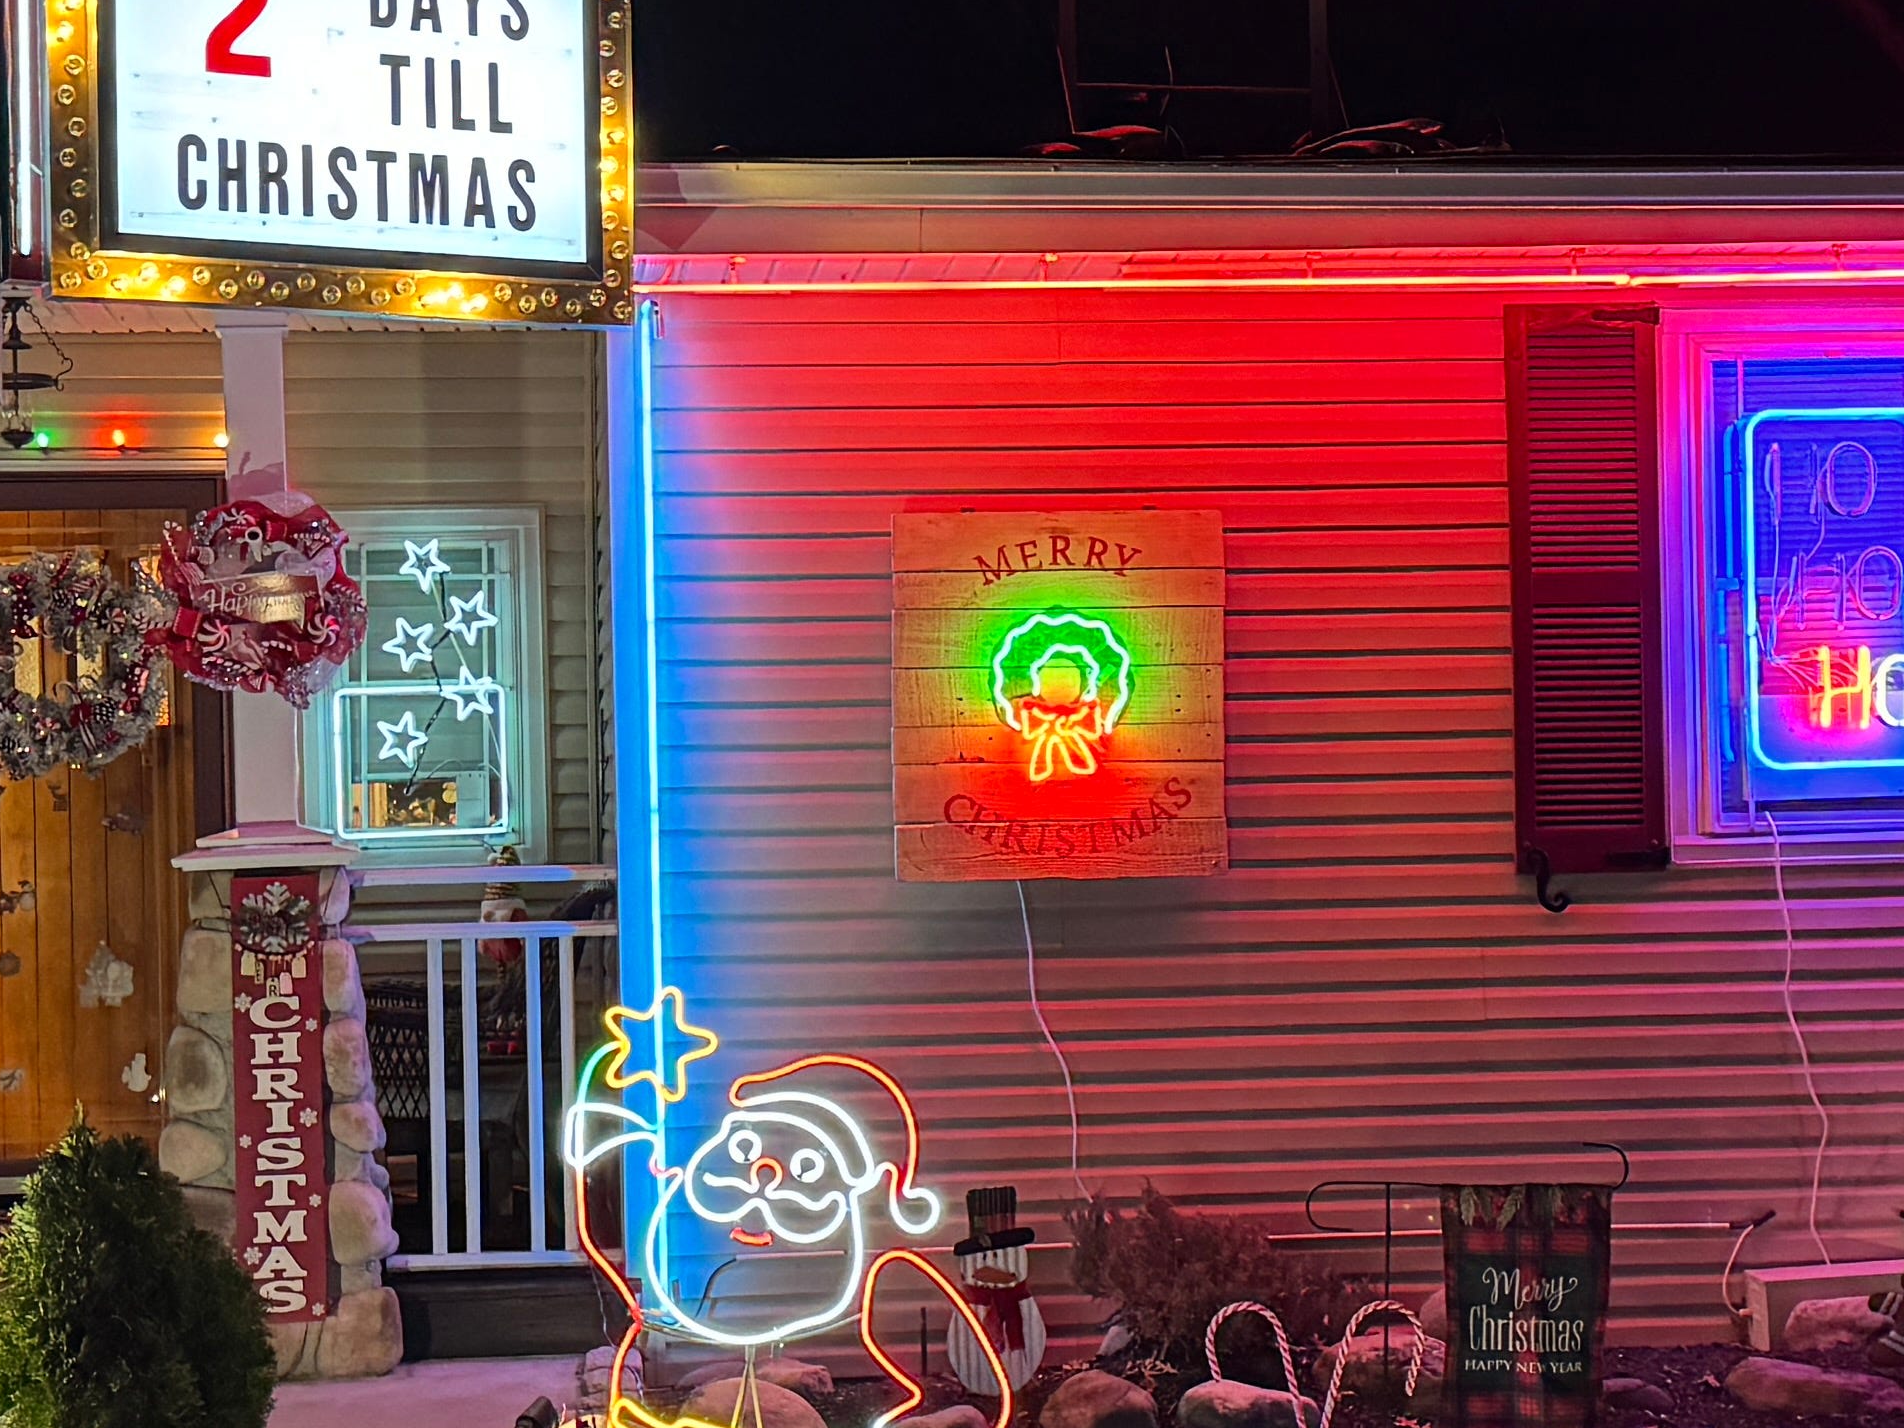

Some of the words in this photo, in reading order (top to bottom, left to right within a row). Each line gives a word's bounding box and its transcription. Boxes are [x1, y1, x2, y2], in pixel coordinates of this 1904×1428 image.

[379, 54, 514, 136] TILL
[176, 133, 537, 232] CHRISTMAS
[973, 535, 1142, 586] MERRY
[943, 776, 1192, 857] CHRISTMAS
[249, 996, 309, 1314] CHRISTMAS
[1482, 1267, 1579, 1312] Merry
[1469, 1304, 1584, 1353] Christmas
[1465, 1359, 1513, 1372] HAPPY
[1516, 1361, 1547, 1374] NEW
[1549, 1361, 1583, 1374] YEAR
